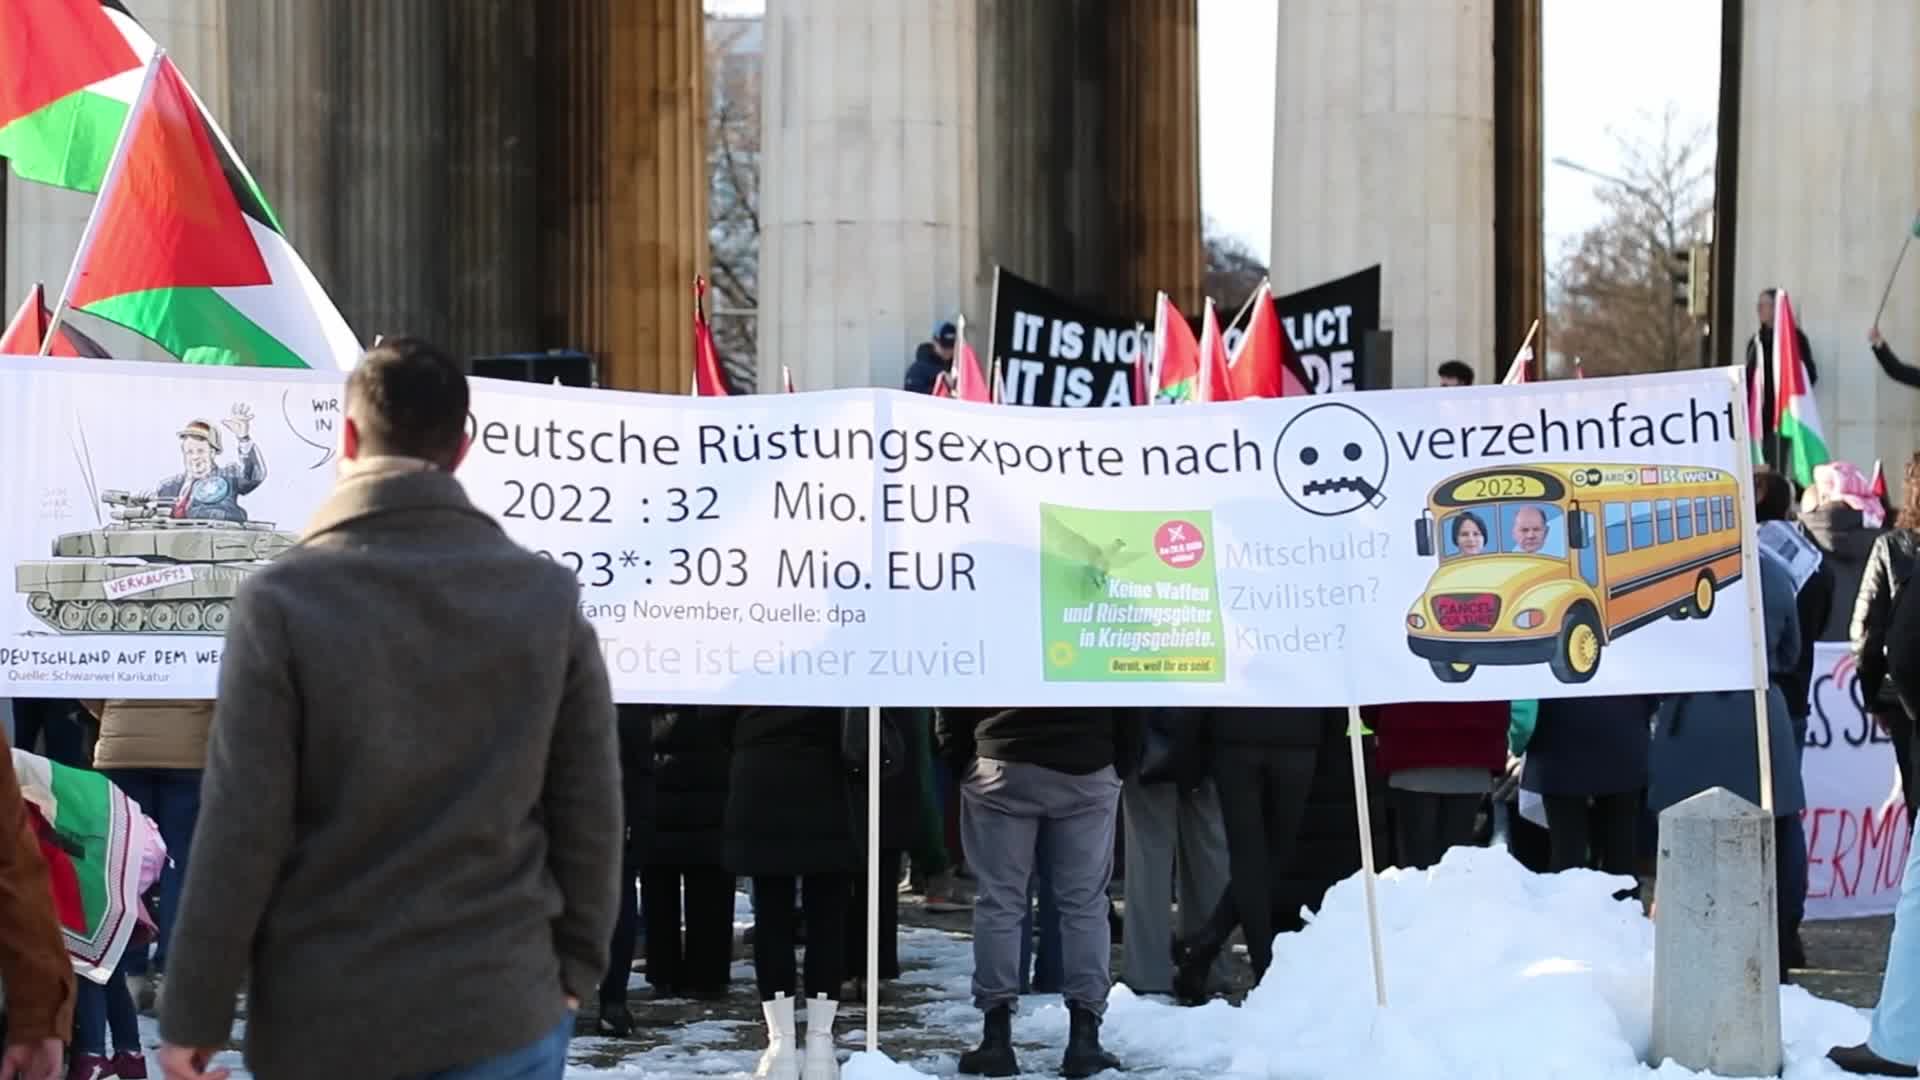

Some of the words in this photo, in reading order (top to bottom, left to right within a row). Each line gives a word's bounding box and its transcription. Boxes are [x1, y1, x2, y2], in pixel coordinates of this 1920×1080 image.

[1012, 311, 1044, 353] IT
[1050, 319, 1085, 360] IS
[1005, 357, 1044, 406] IT
[1051, 365, 1094, 408] IS
[1102, 370, 1132, 408] A
[311, 398, 340, 413] WIR
[315, 418, 332, 431] IN
[466, 410, 680, 466] eutsche
[699, 423, 1123, 477] Rüstungsexporte
[1142, 429, 1261, 476] nach
[1397, 398, 1735, 461] verzehnfacht
[503, 479, 613, 524] 2022
[665, 486, 720, 522] 32
[773, 480, 866, 522] Mio.
[882, 483, 971, 524] EUR
[1475, 478, 1527, 498] 2023
[1225, 530, 1391, 569] Mitschuld?
[110, 567, 187, 593] VERKAUFT!
[668, 547, 749, 588] 303
[777, 549, 871, 589] Mio.
[888, 551, 977, 591] EUR
[1108, 579, 1153, 599] Keine
[1156, 582, 1210, 601] Waffen
[1230, 575, 1380, 612] Zivilisten?
[578, 599, 627, 623] fang
[633, 600, 743, 623] November,
[749, 602, 822, 625] Quelle:
[826, 604, 867, 627] dpa
[1063, 603, 1094, 624] und
[1096, 603, 1213, 626] Rüstungsgüter
[1079, 629, 1095, 648] in
[1098, 627, 1216, 651] Kriegsgebiete.
[1235, 623, 1346, 654] Kinder?
[0, 648, 110, 666] DEUTSCHLAND
[117, 650, 146, 664] AUF
[155, 650, 187, 664] DEM
[599, 637, 681, 675] Tote
[695, 639, 742, 676] ist
[752, 640, 856, 676] einer
[867, 639, 986, 677] zuviel
[118, 671, 170, 682] Karikatur
